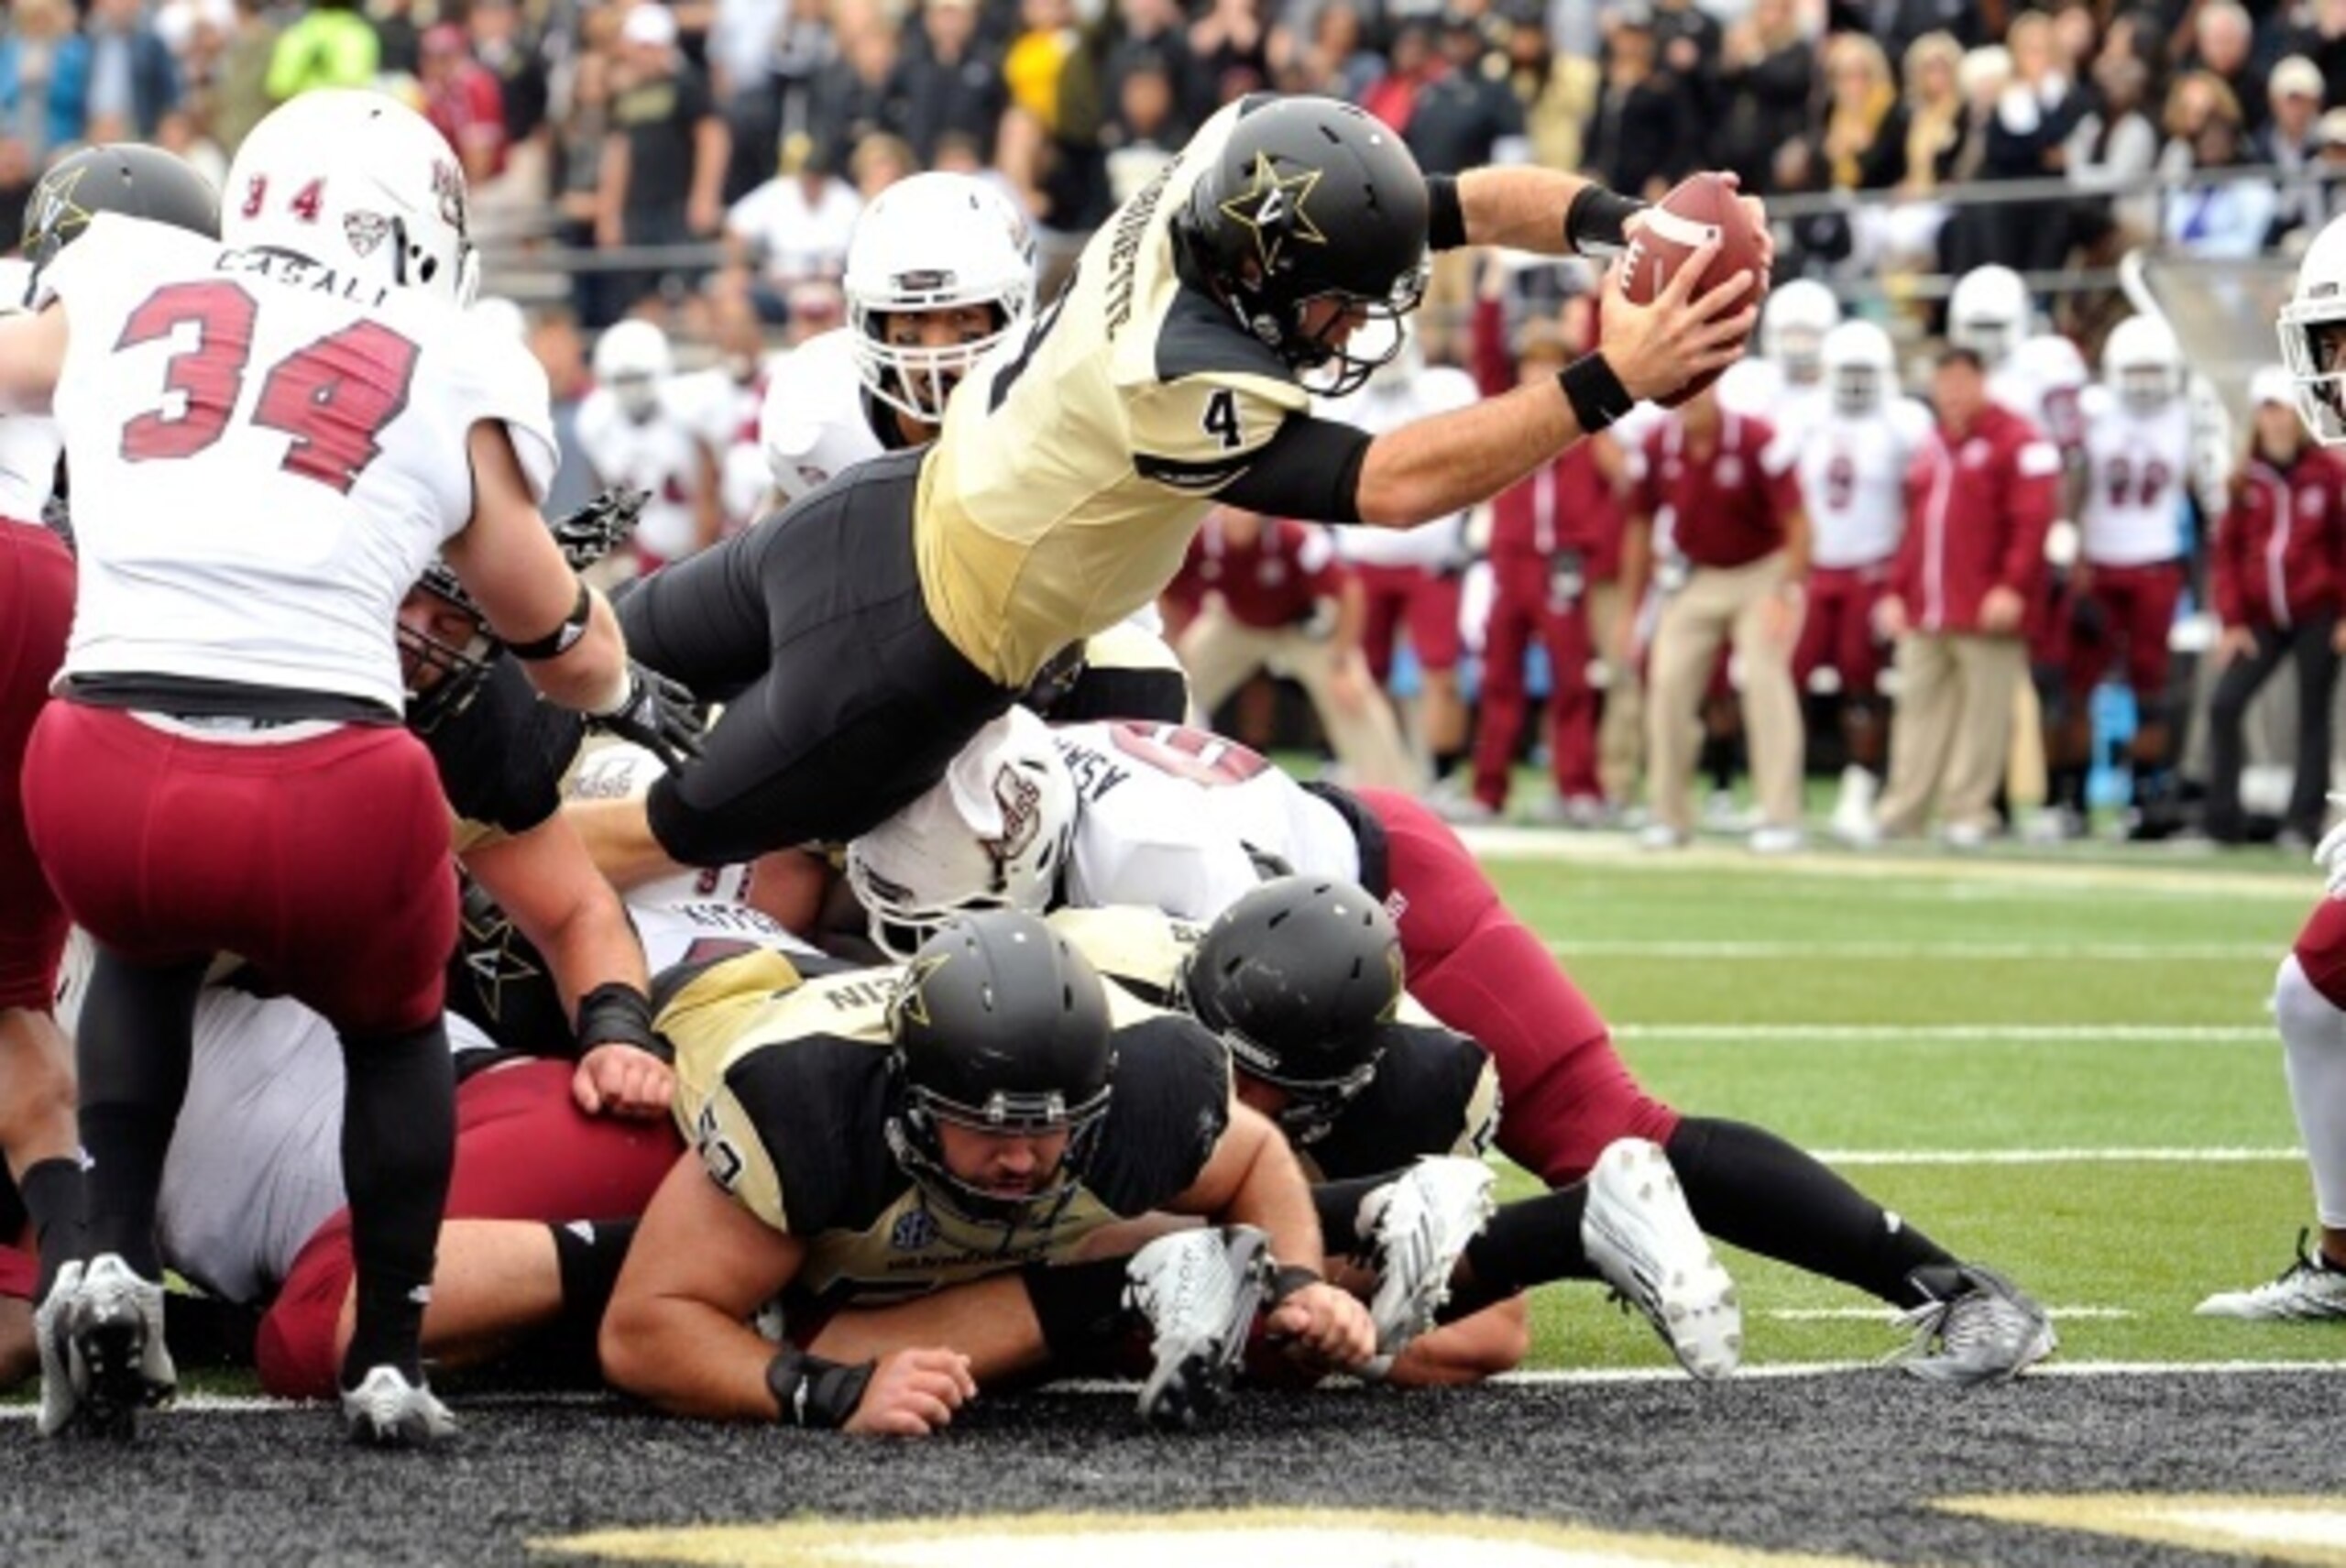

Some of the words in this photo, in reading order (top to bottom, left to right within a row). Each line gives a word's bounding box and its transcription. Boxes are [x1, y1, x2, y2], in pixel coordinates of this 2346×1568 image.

[214, 247, 389, 307] CASALI
[111, 278, 422, 498] 34
[1201, 387, 1244, 451] 4
